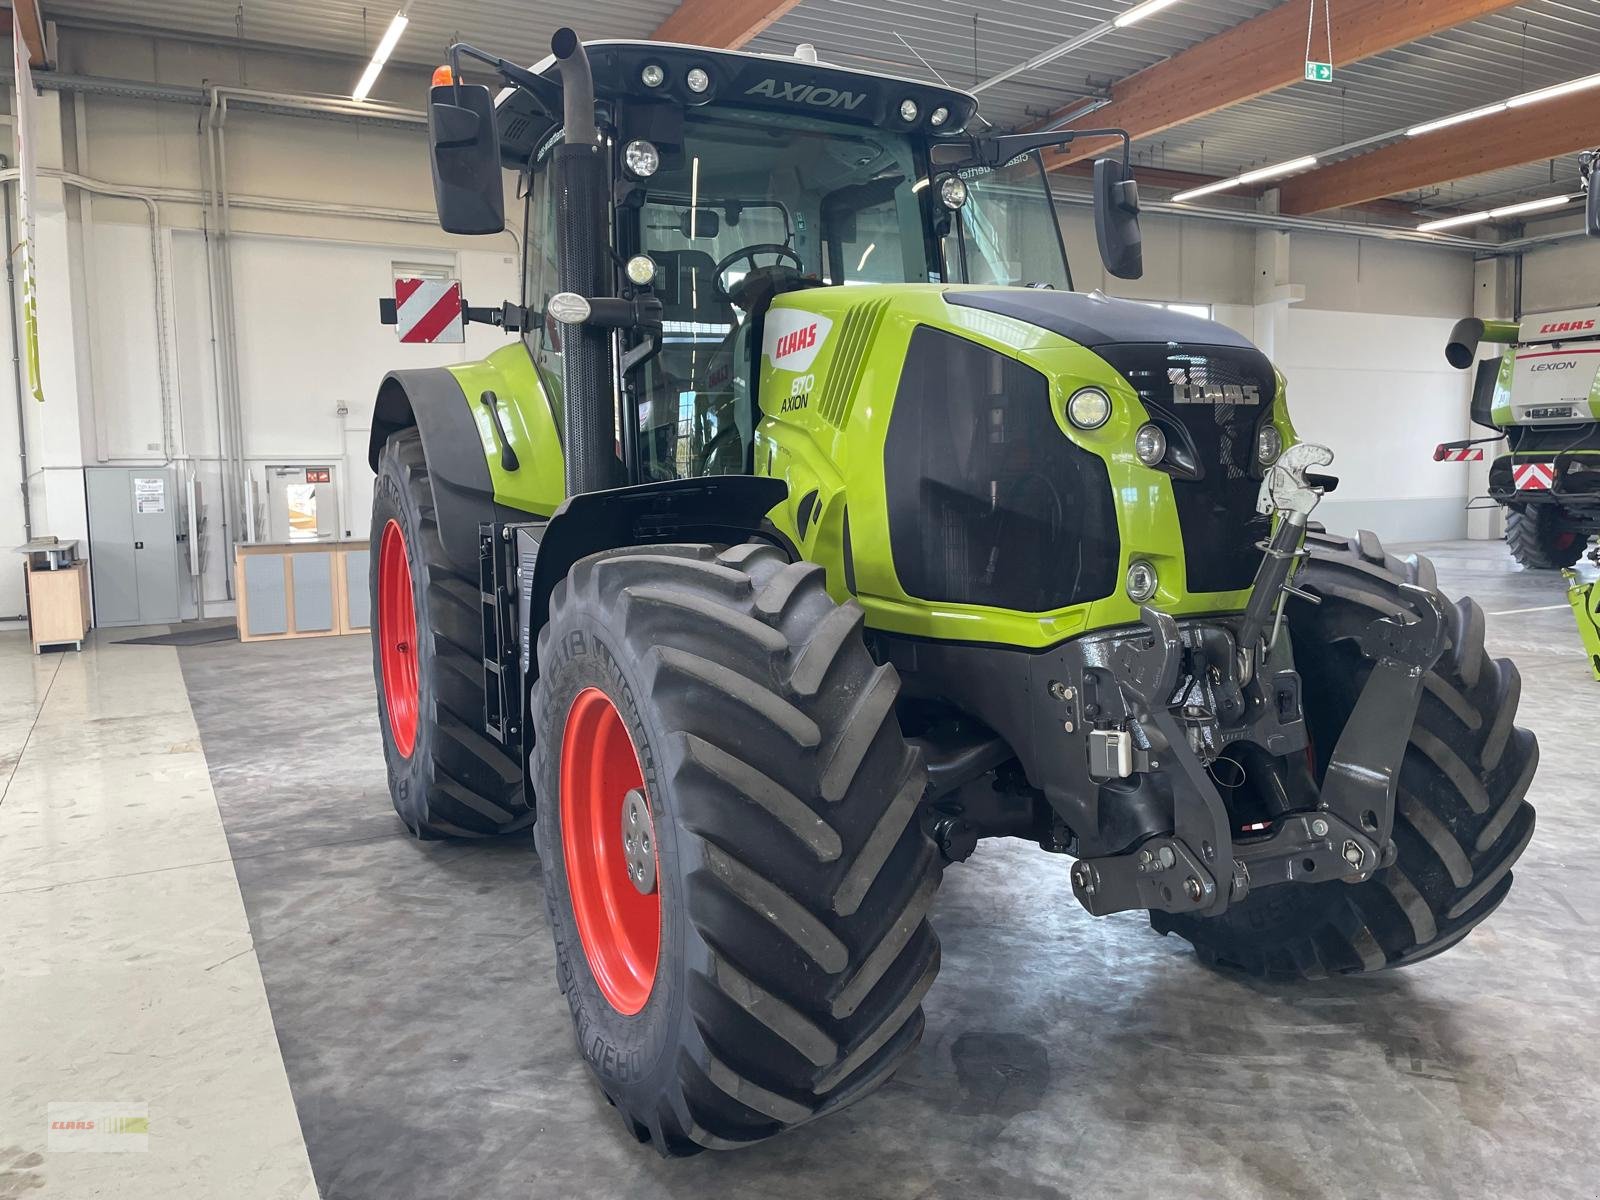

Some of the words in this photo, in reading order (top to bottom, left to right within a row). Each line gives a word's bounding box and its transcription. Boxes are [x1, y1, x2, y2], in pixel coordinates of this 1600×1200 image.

[744, 79, 867, 110] AXION
[1540, 320, 1595, 333] CLAAS
[776, 323, 818, 360] CLAAS
[1530, 361, 1577, 372] LEXION
[791, 374, 815, 395] 870
[1173, 384, 1260, 405] CLAAS
[781, 393, 809, 414] AXION
